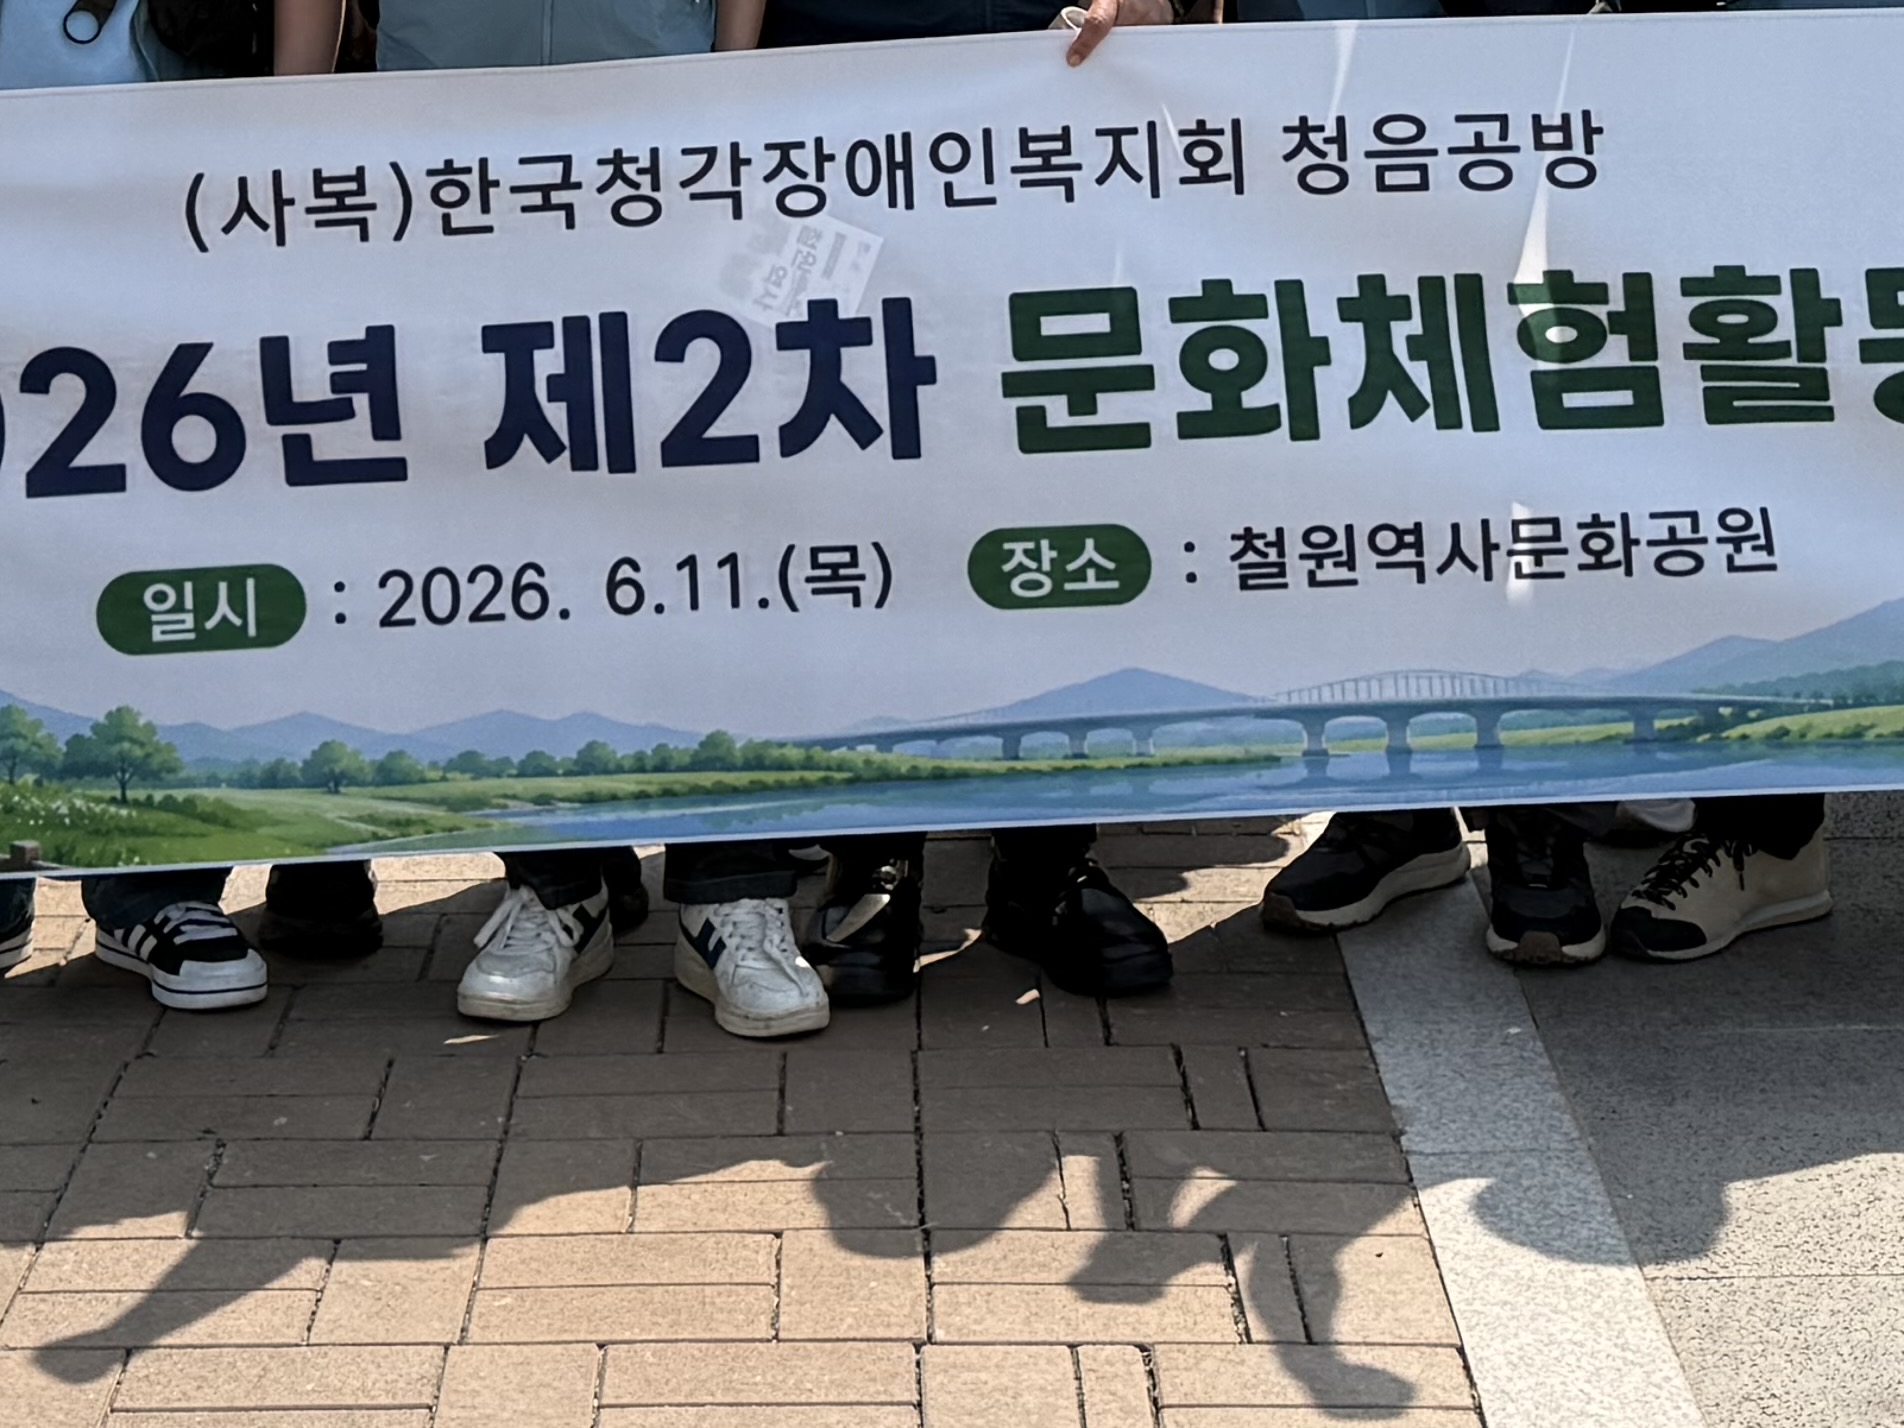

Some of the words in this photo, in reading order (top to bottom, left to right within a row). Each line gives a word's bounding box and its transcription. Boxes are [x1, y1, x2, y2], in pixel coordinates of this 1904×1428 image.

[186, 118, 1244, 252] (사복)한국청각장애인복지회
[1283, 109, 1604, 196] 청음공방
[481, 296, 938, 475] 제2차
[143, 576, 259, 642] 일시
[378, 561, 571, 629] 2026.
[605, 541, 893, 616] 6.11.(목)
[1002, 538, 1119, 597] 장소
[1229, 506, 1778, 592] 철원역사문화공원
